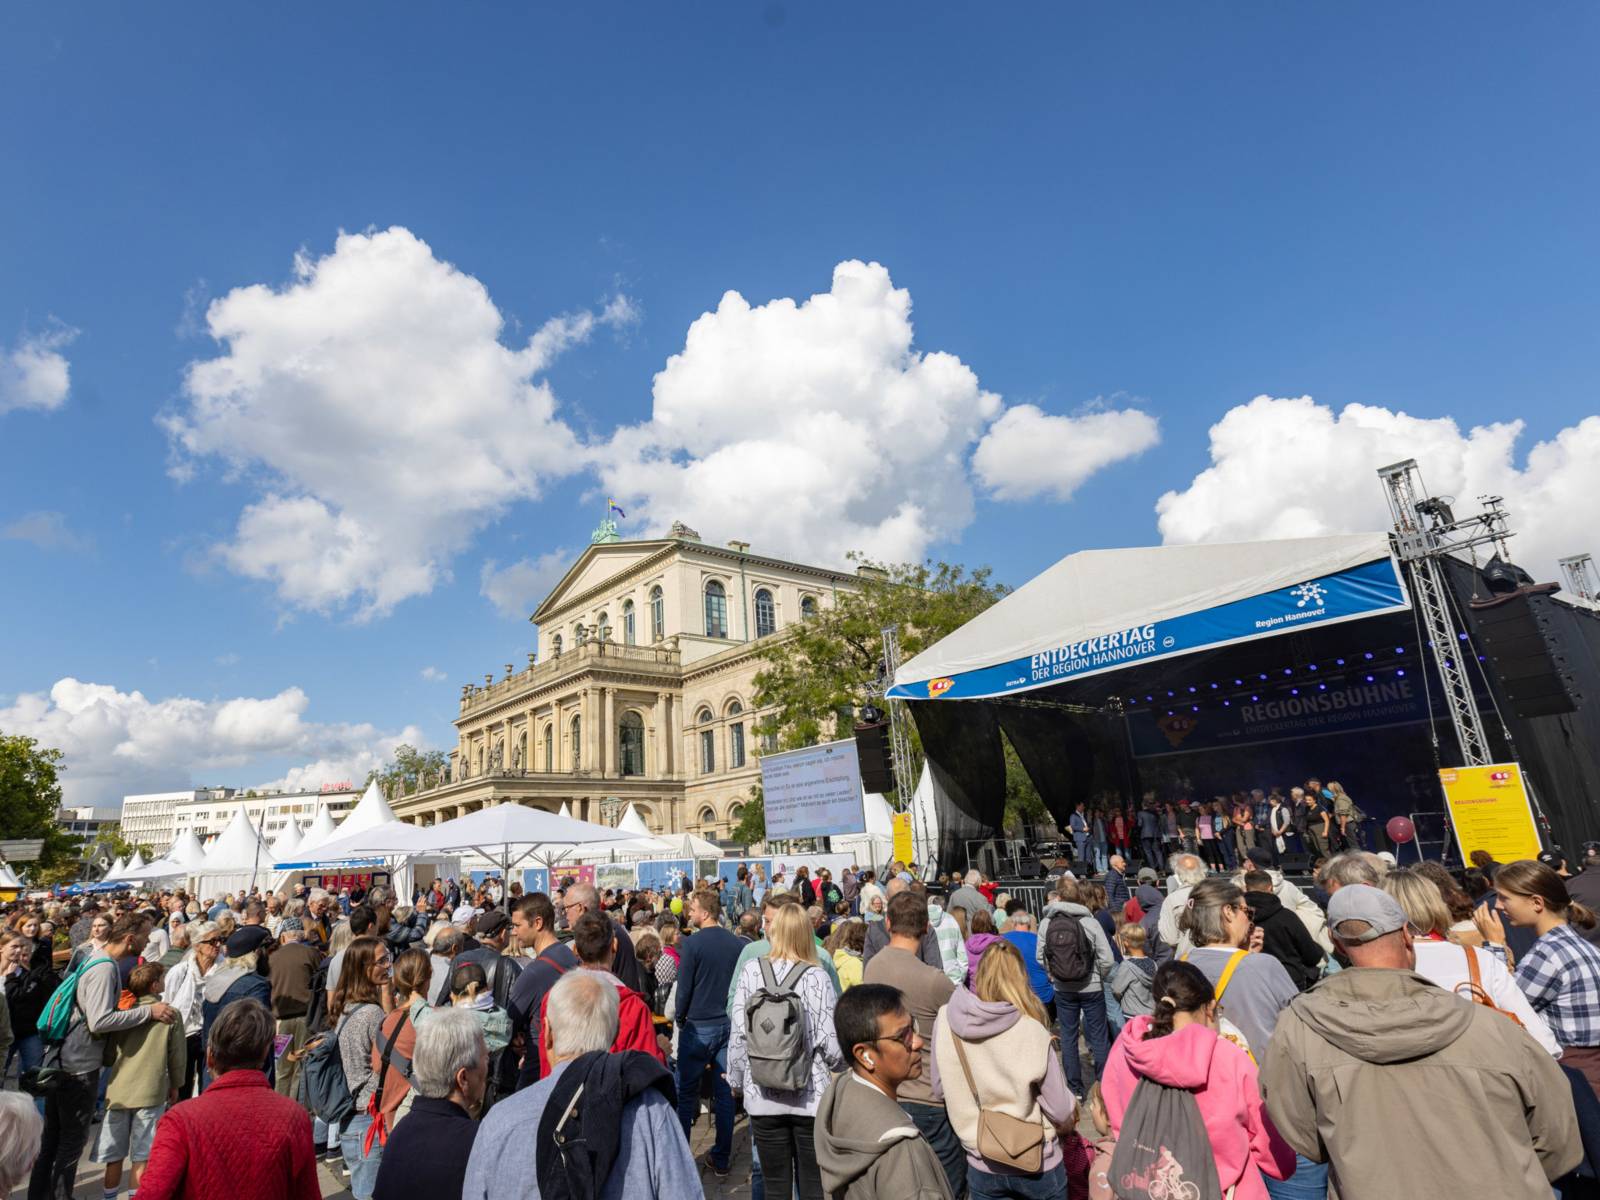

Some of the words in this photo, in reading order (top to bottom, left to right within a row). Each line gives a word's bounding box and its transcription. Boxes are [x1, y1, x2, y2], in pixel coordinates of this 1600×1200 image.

[1255, 617, 1284, 628] Region
[1284, 608, 1326, 622] Hannover
[1031, 624, 1156, 669] ENTDECKERTAG
[1032, 667, 1050, 681] DER
[1053, 656, 1090, 676] REGION
[1093, 640, 1156, 666] HANNOVER
[1240, 681, 1413, 723] REGIONSBÜHNE
